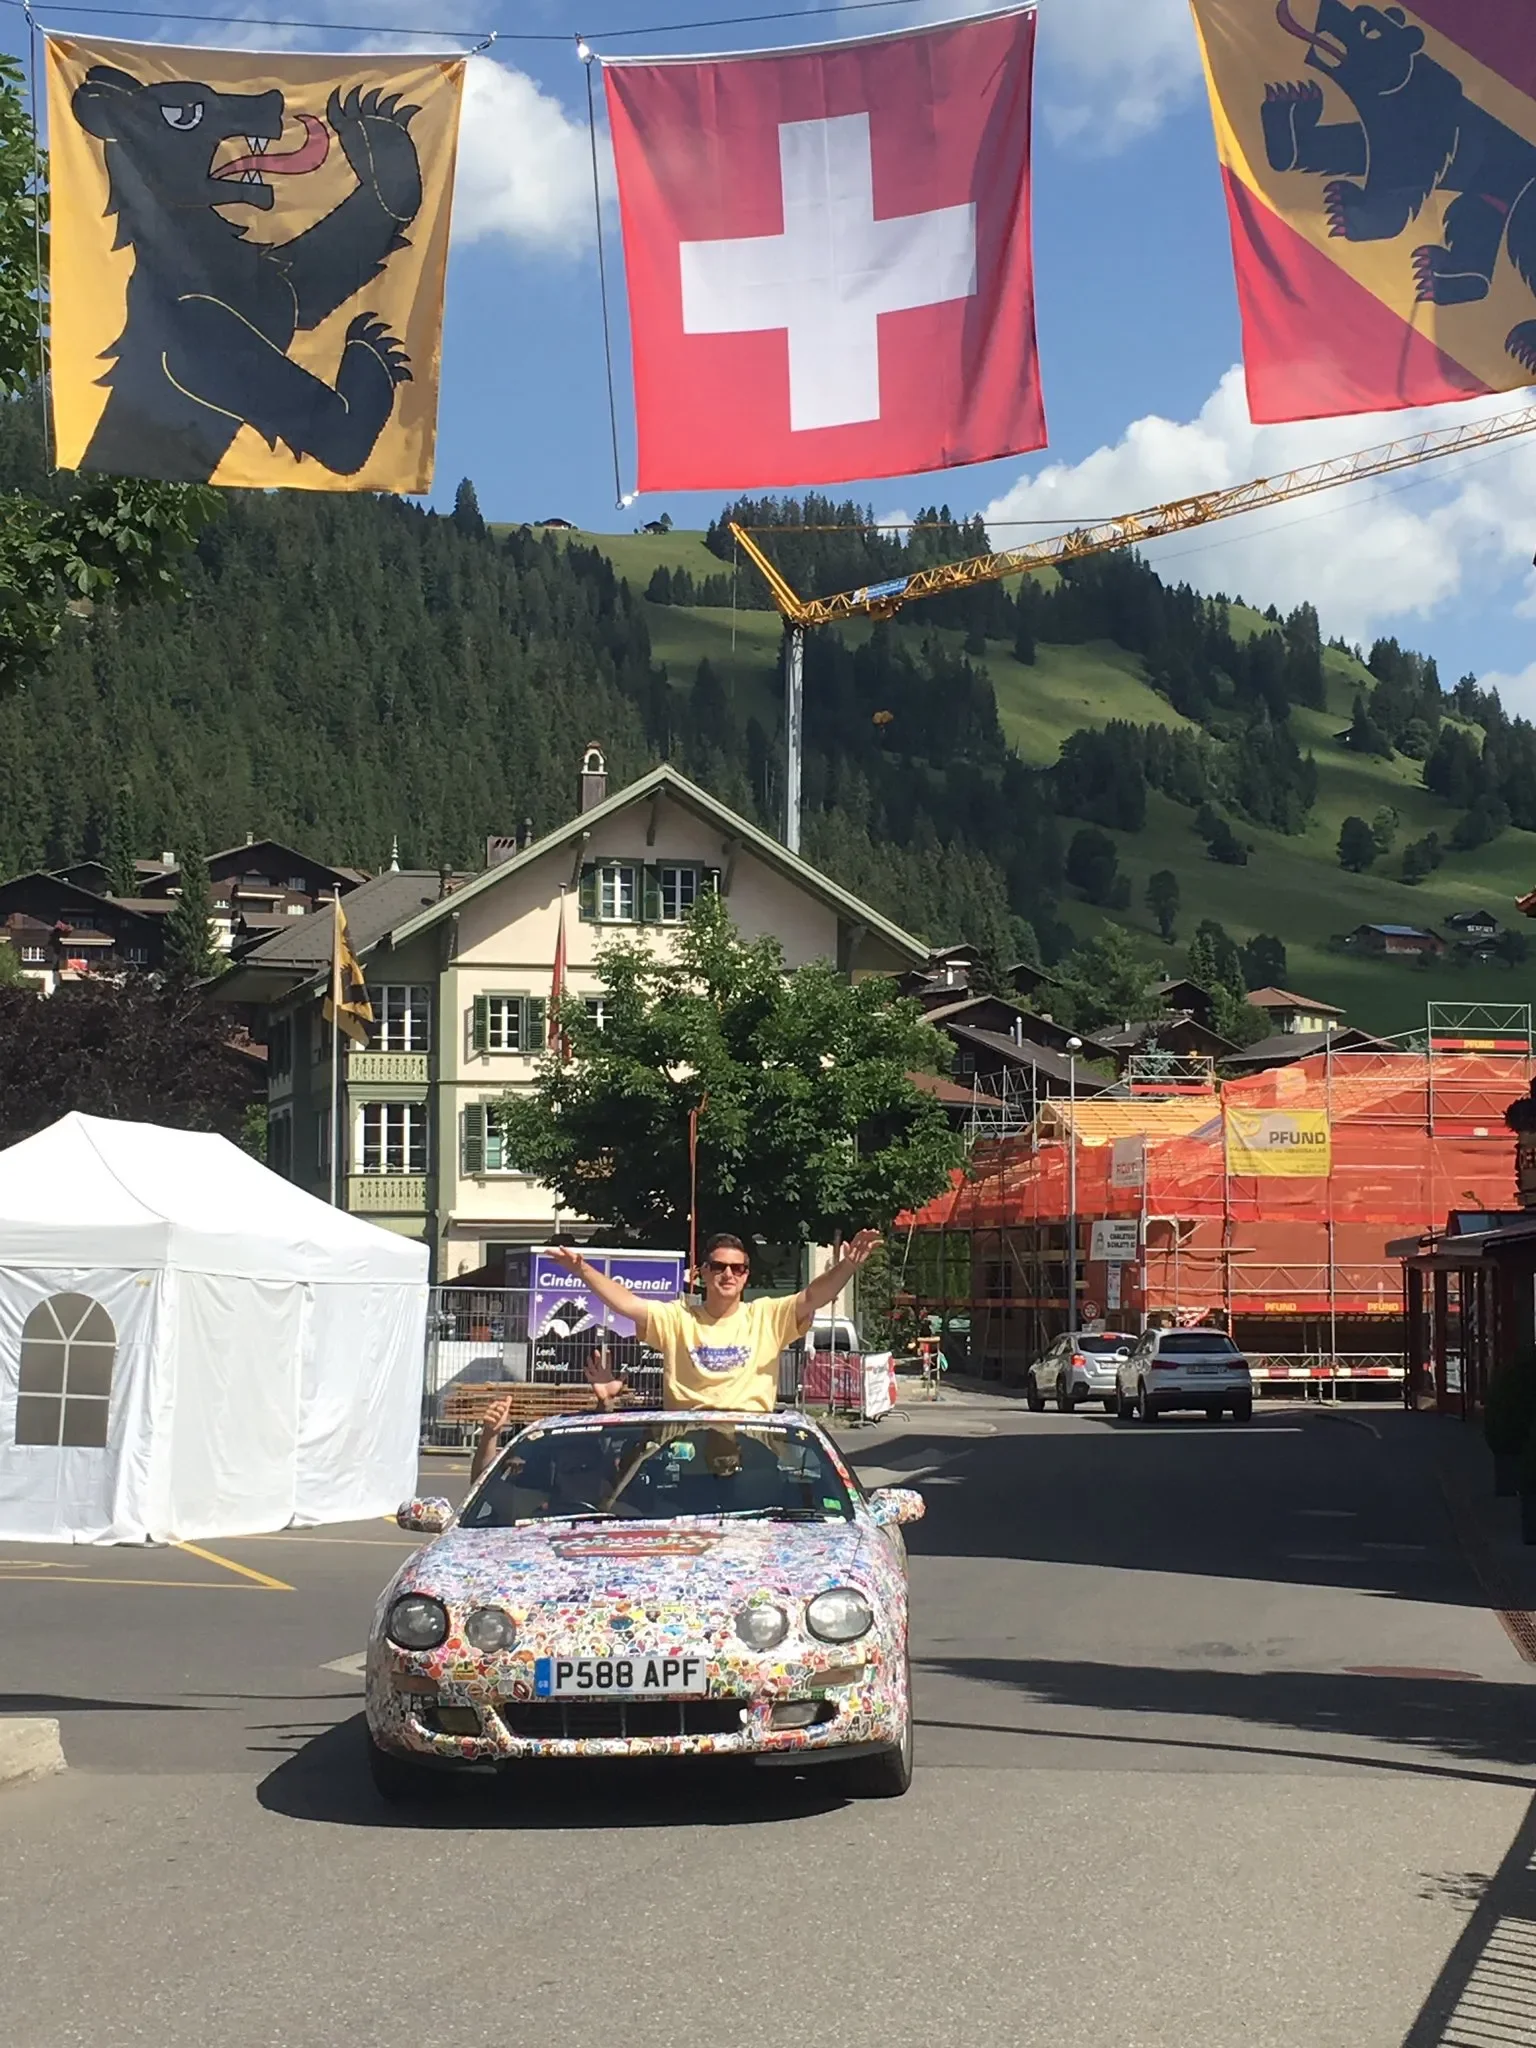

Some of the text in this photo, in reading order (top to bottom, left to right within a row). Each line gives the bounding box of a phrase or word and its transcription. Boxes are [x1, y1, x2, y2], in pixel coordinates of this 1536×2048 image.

[1269, 1131, 1326, 1145] PFUND
[539, 1273, 587, 1288] Ciném
[1264, 1302, 1297, 1311] PFUND
[1367, 1302, 1399, 1311] PFUND
[535, 1346, 556, 1357] Lenk
[555, 1658, 701, 1690] P588 APF
